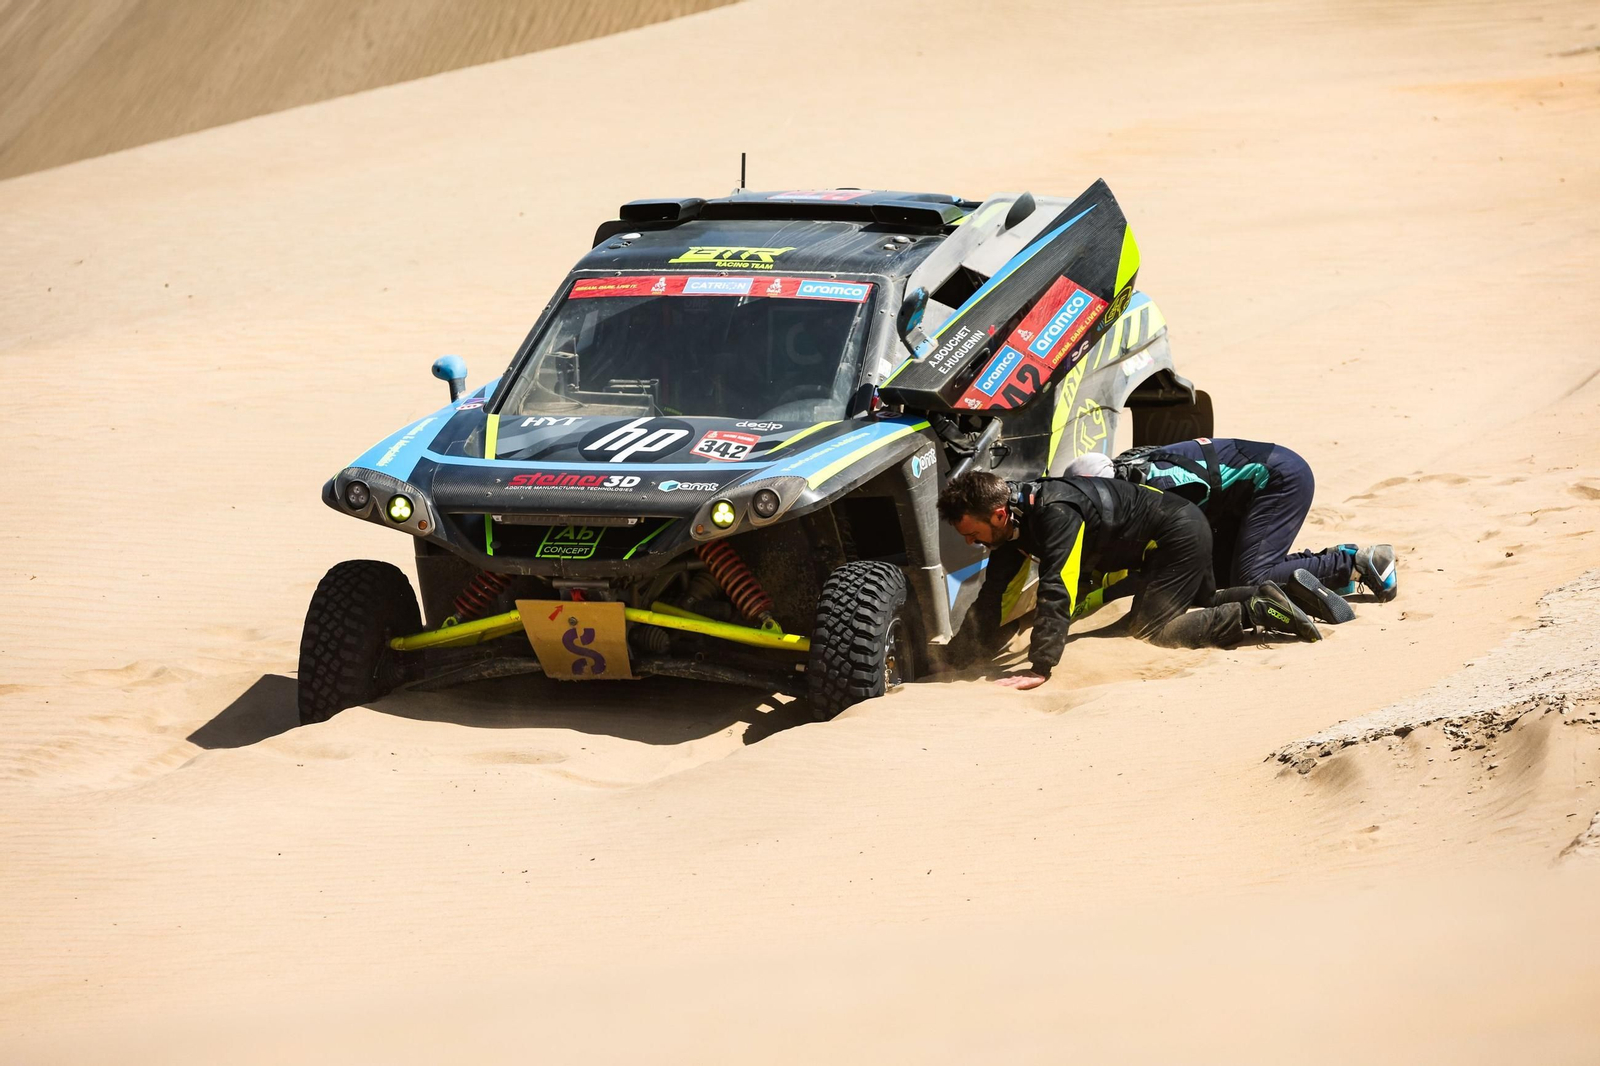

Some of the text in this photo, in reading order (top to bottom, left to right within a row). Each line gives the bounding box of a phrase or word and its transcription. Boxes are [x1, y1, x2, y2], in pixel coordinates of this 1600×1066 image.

[715, 261, 750, 269] RACING
[691, 281, 748, 291] CATRION
[803, 284, 863, 296] aramco
[1036, 296, 1085, 351] aramco
[928, 325, 971, 368] A.BOUCHET
[938, 330, 986, 375] E.HUGUENIN
[982, 352, 1015, 390] aramco
[989, 364, 1041, 409] 42
[521, 417, 583, 428] HYT
[584, 416, 690, 463] hp
[698, 440, 748, 459] 342
[543, 546, 590, 555] CONCEPT
